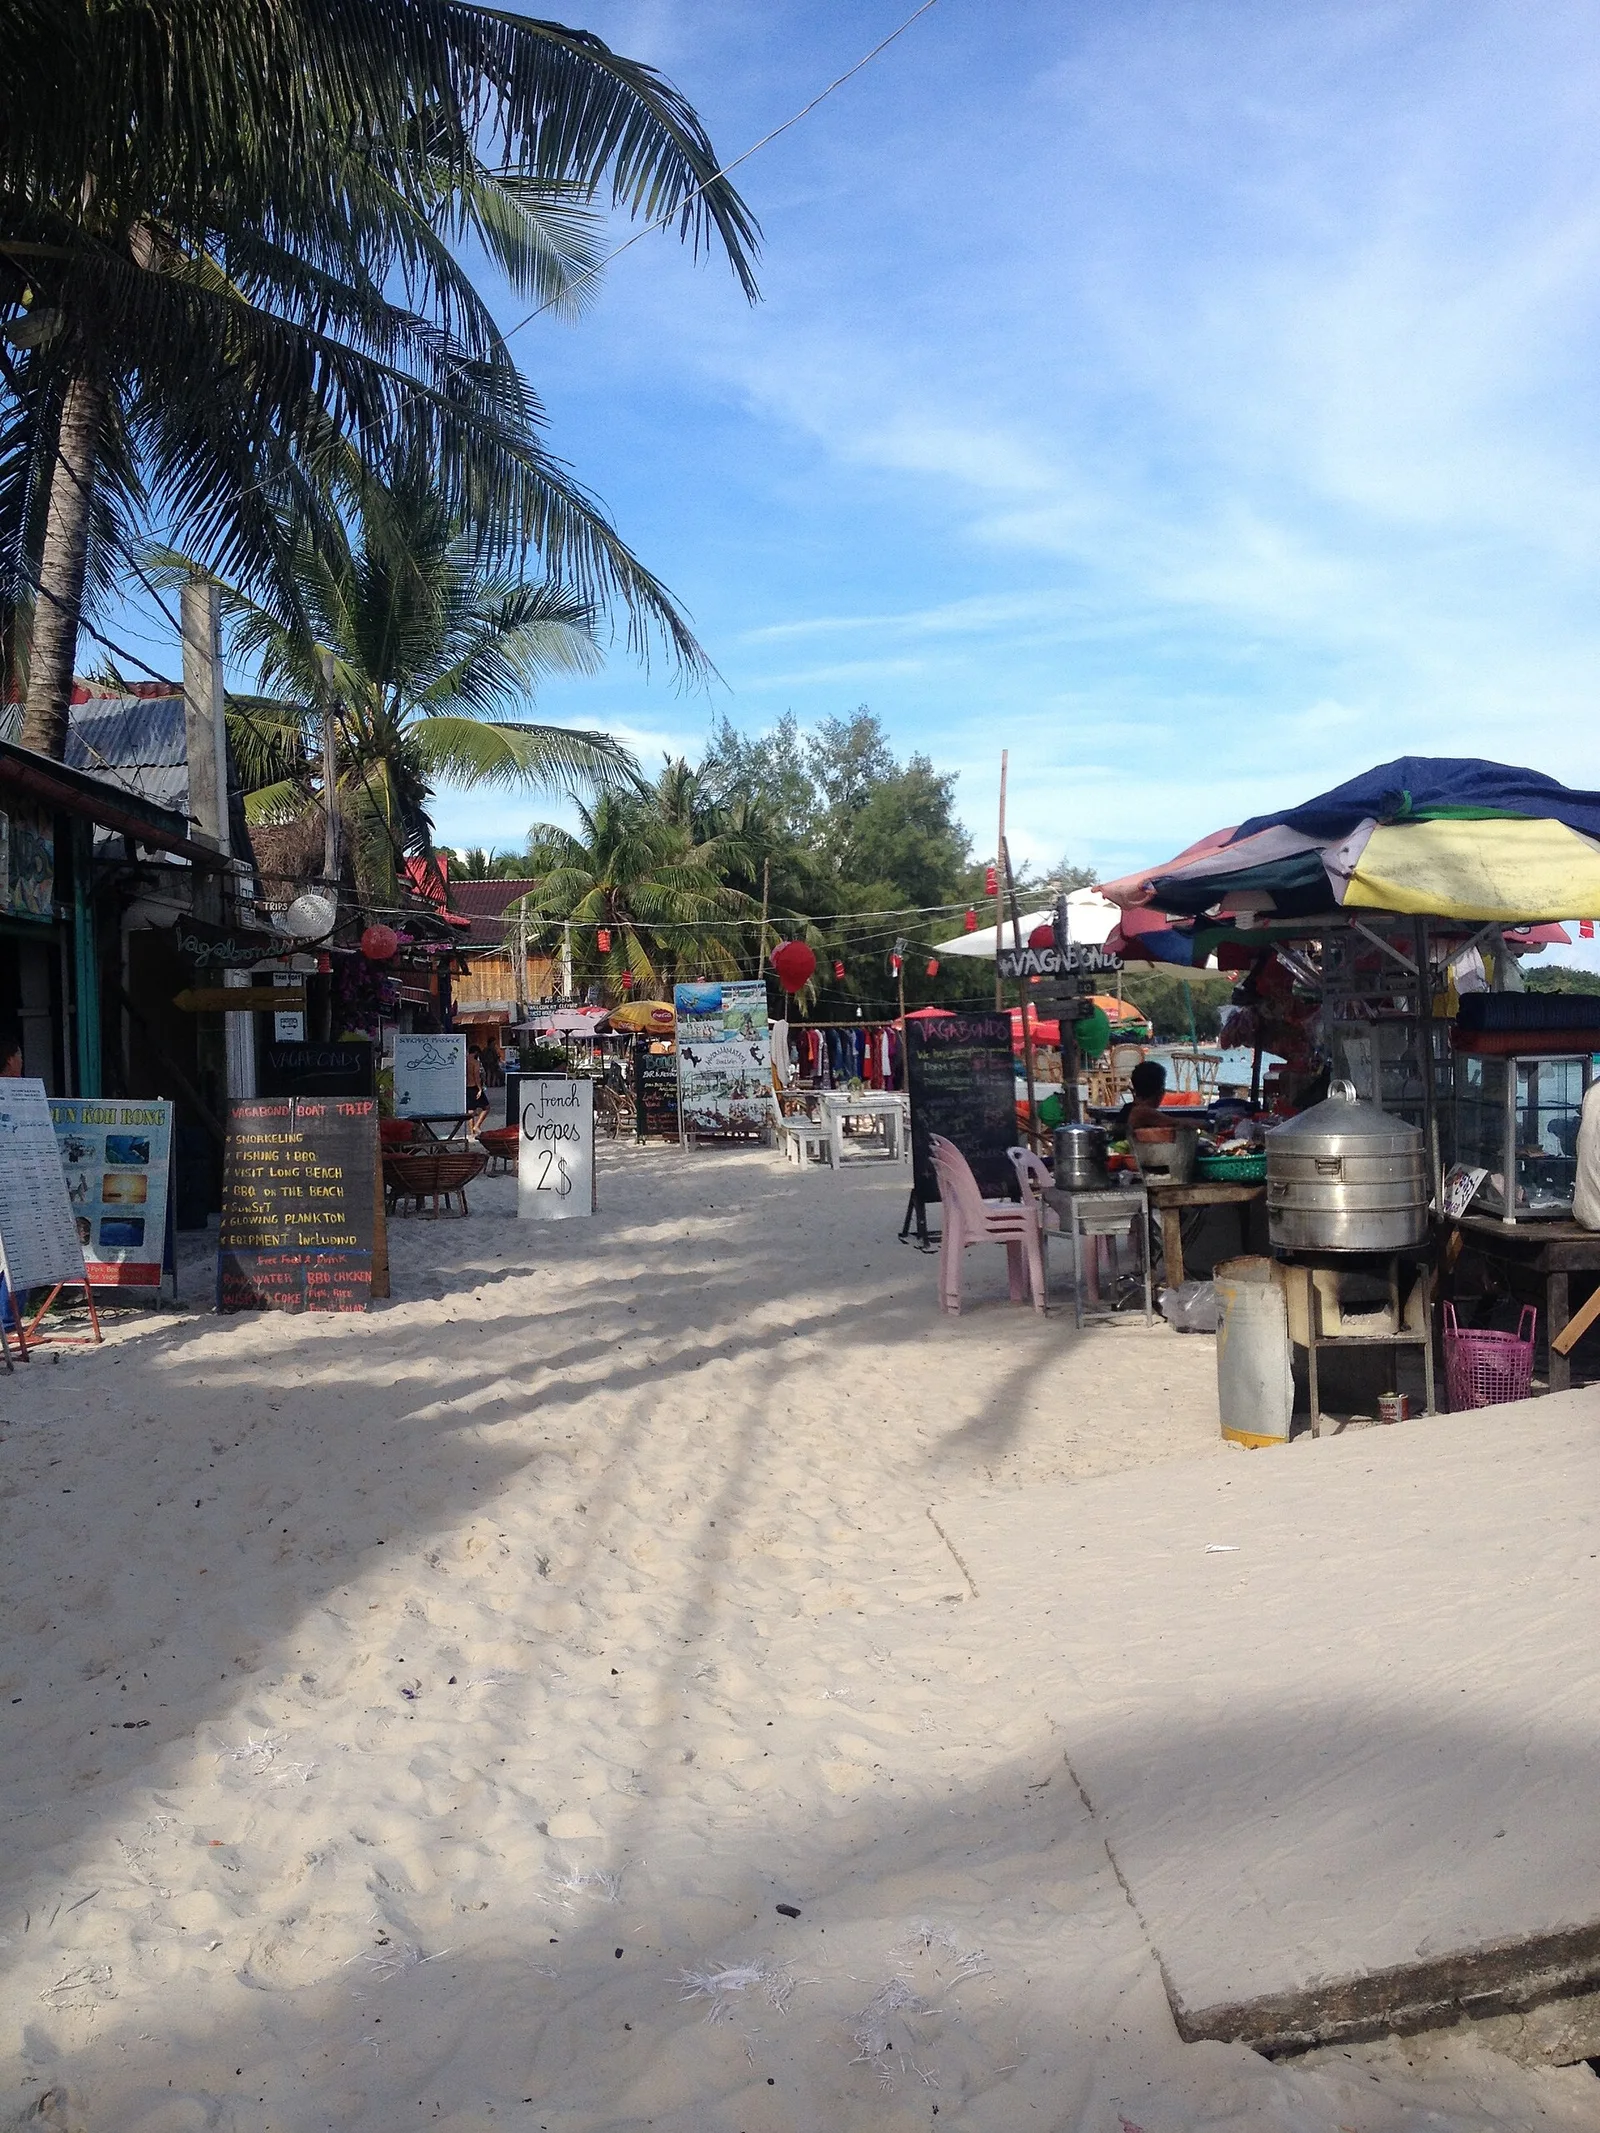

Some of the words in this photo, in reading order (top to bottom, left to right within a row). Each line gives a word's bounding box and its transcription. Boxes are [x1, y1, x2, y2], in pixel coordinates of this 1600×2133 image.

[234, 897, 259, 909] BOAT
[262, 901, 288, 911] TRIPS
[50, 1106, 77, 1124] UN
[81, 1105, 118, 1126] KOH
[120, 1108, 166, 1126] RONG
[231, 1106, 289, 1118] VAGABOND
[295, 1103, 327, 1117] BOAT
[336, 1100, 374, 1116] TRIP
[522, 1103, 581, 1154] Crêpes
[236, 1133, 304, 1145] SNORKELING
[236, 1151, 280, 1162] FISHING
[294, 1151, 317, 1162] BBQ
[234, 1167, 264, 1178] VISIT
[269, 1167, 300, 1177] LONG
[305, 1167, 343, 1179] BEACH
[233, 1185, 257, 1197] BBQ
[281, 1186, 303, 1197] THE
[309, 1186, 344, 1197] BEACH
[230, 1214, 279, 1228] GLOWING
[284, 1212, 346, 1225] PLANKTON
[252, 1272, 293, 1286] WATER
[334, 1270, 372, 1284] CHICKEN
[274, 1292, 300, 1304] COKE
